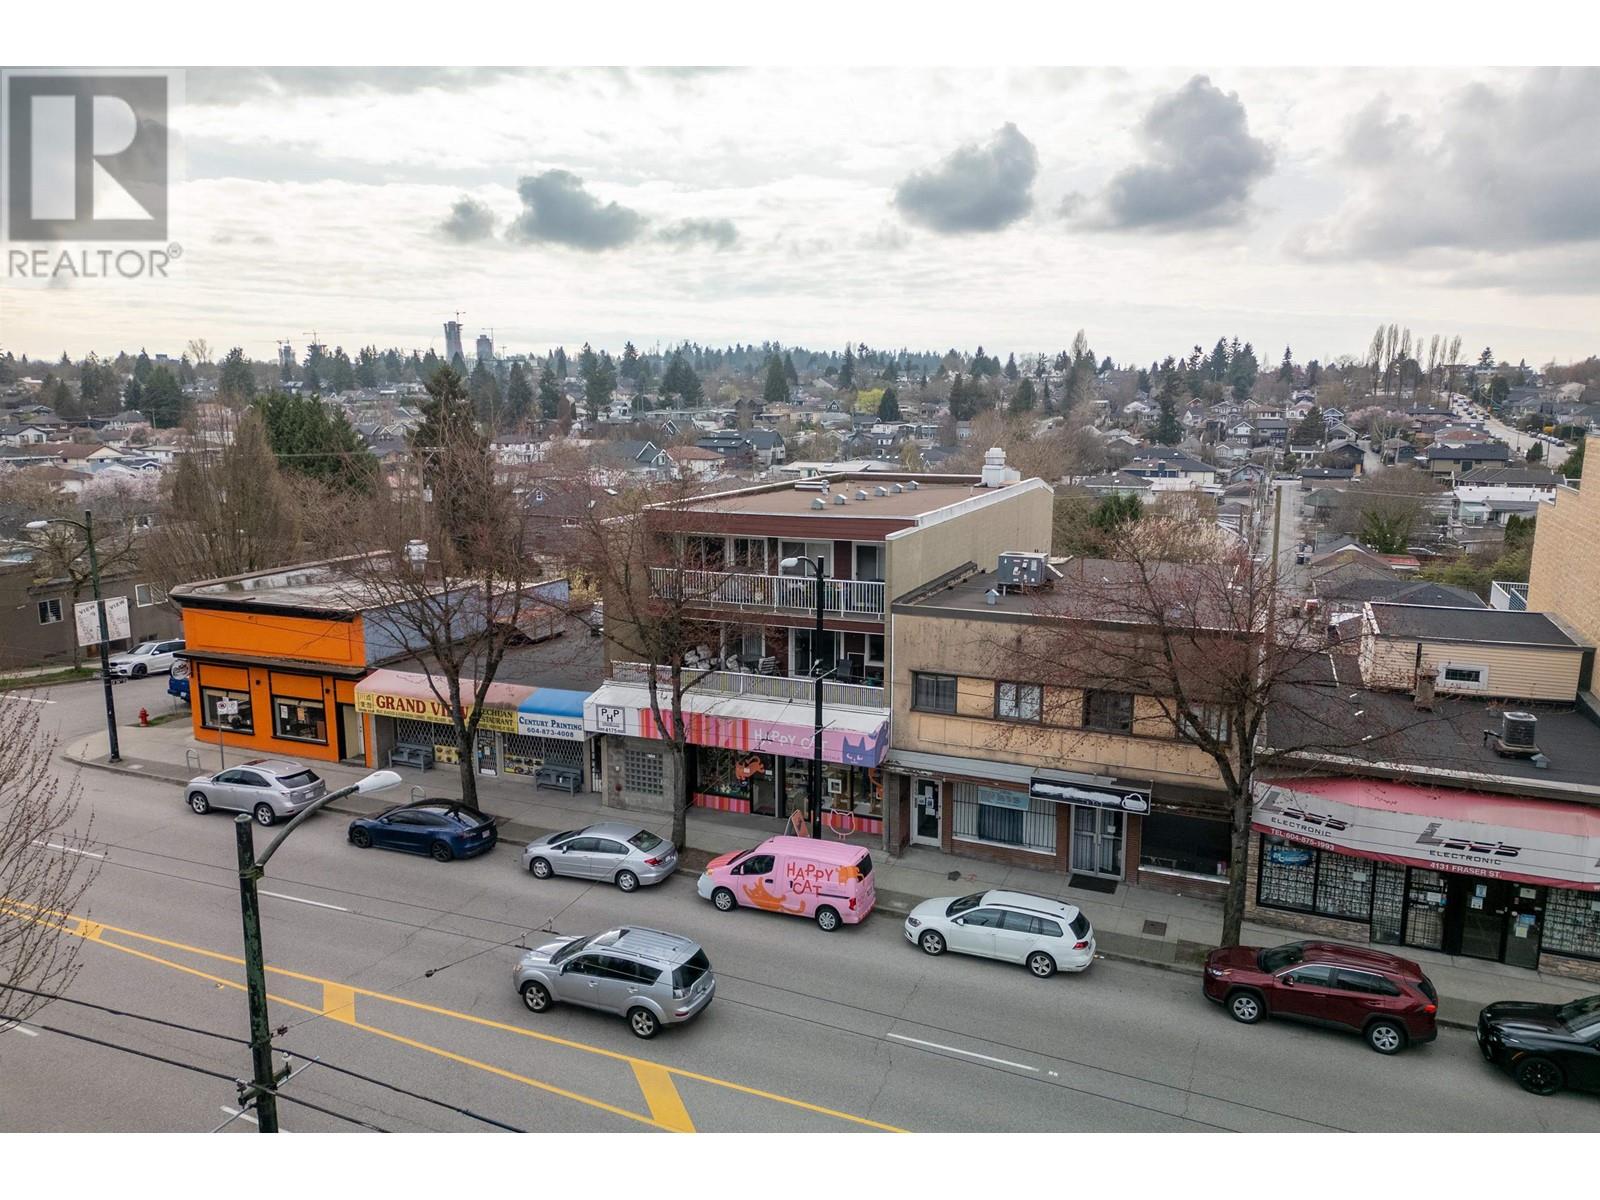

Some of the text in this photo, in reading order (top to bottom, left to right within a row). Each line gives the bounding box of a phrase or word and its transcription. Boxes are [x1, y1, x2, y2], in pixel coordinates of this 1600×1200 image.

[376, 694, 426, 714] GRAND
[430, 701, 469, 720] VIW
[519, 716, 549, 728] CENTURY
[550, 719, 583, 731] PRINTING
[526, 726, 574, 738] 604-873-4008
[1271, 817, 1332, 837] ELECTRONIC
[1429, 850, 1502, 865] ELECTRONIC
[786, 861, 834, 882] HAPPY
[1430, 862, 1449, 871] 4131
[1451, 864, 1487, 876] FRASER
[792, 879, 823, 898] CAT
